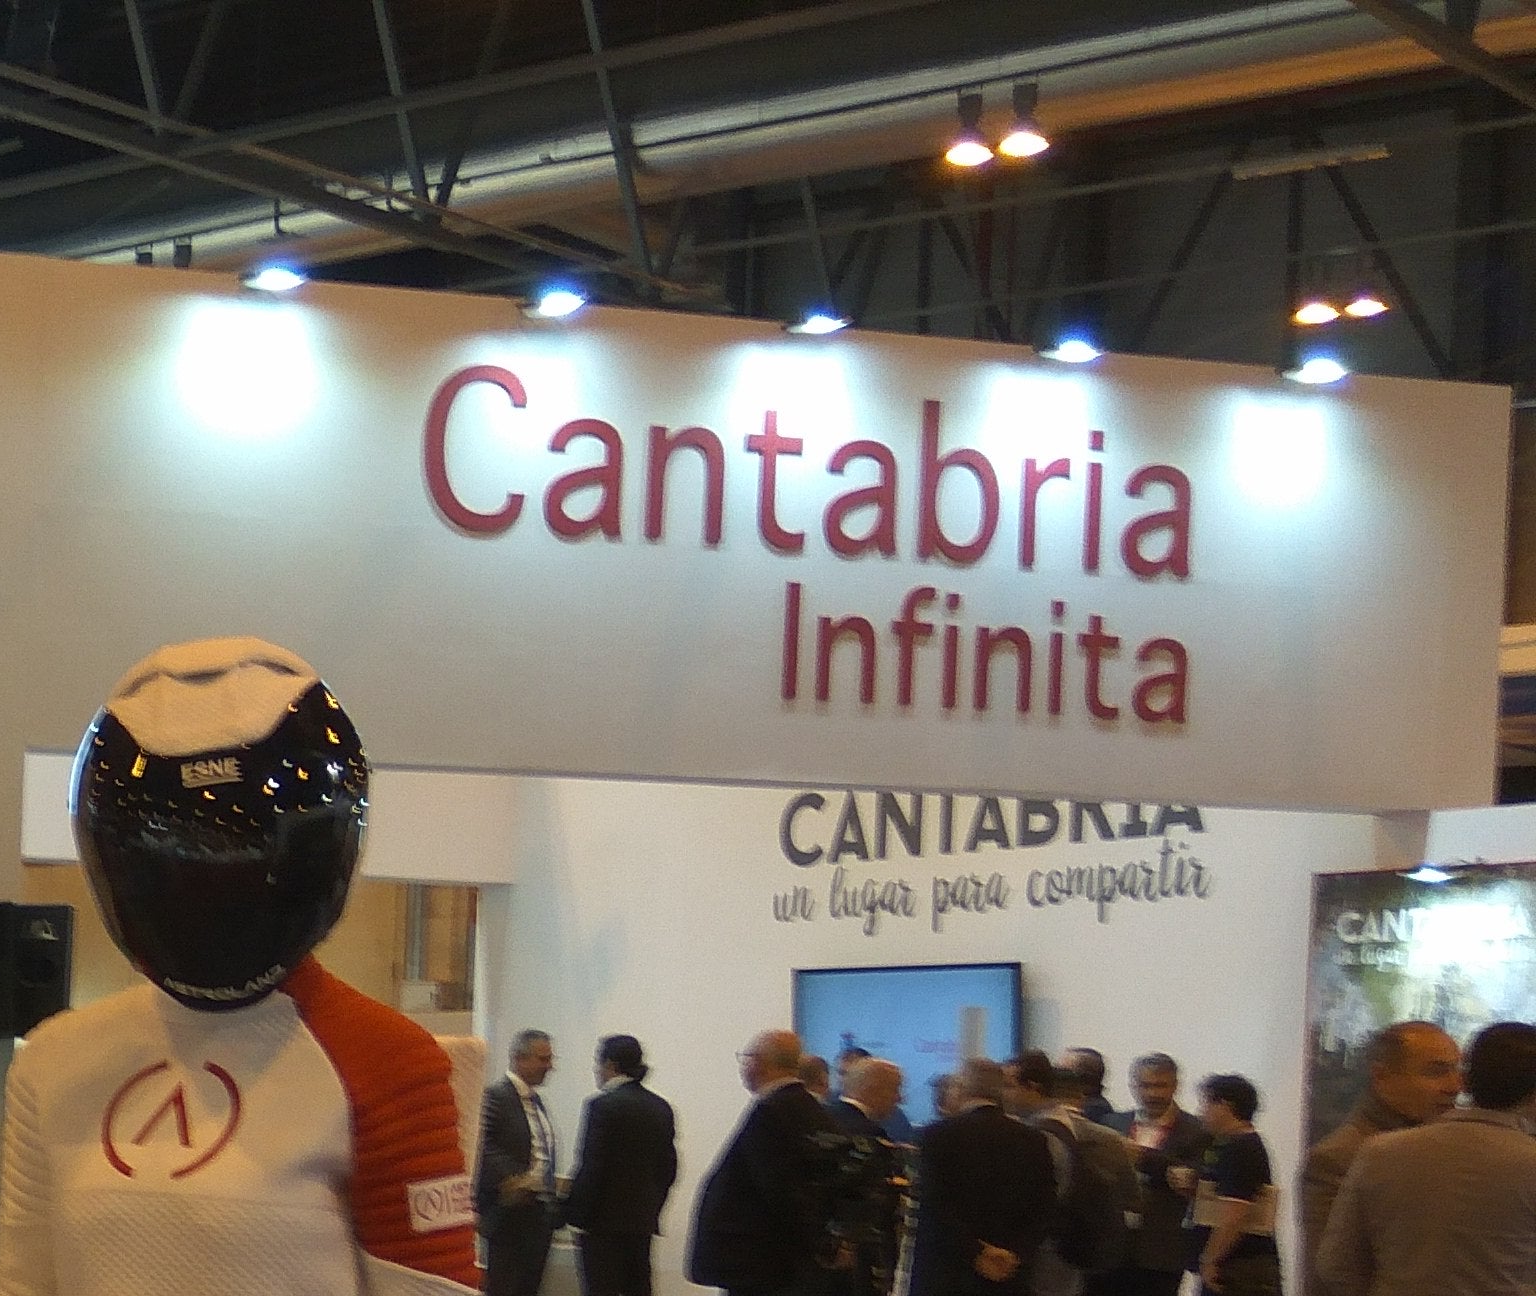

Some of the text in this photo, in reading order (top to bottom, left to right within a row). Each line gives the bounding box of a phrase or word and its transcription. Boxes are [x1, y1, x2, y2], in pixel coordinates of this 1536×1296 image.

[422, 364, 1193, 580] Cantabria
[780, 582, 1189, 724] Infinita
[772, 838, 1211, 936] un lugar para compartir
